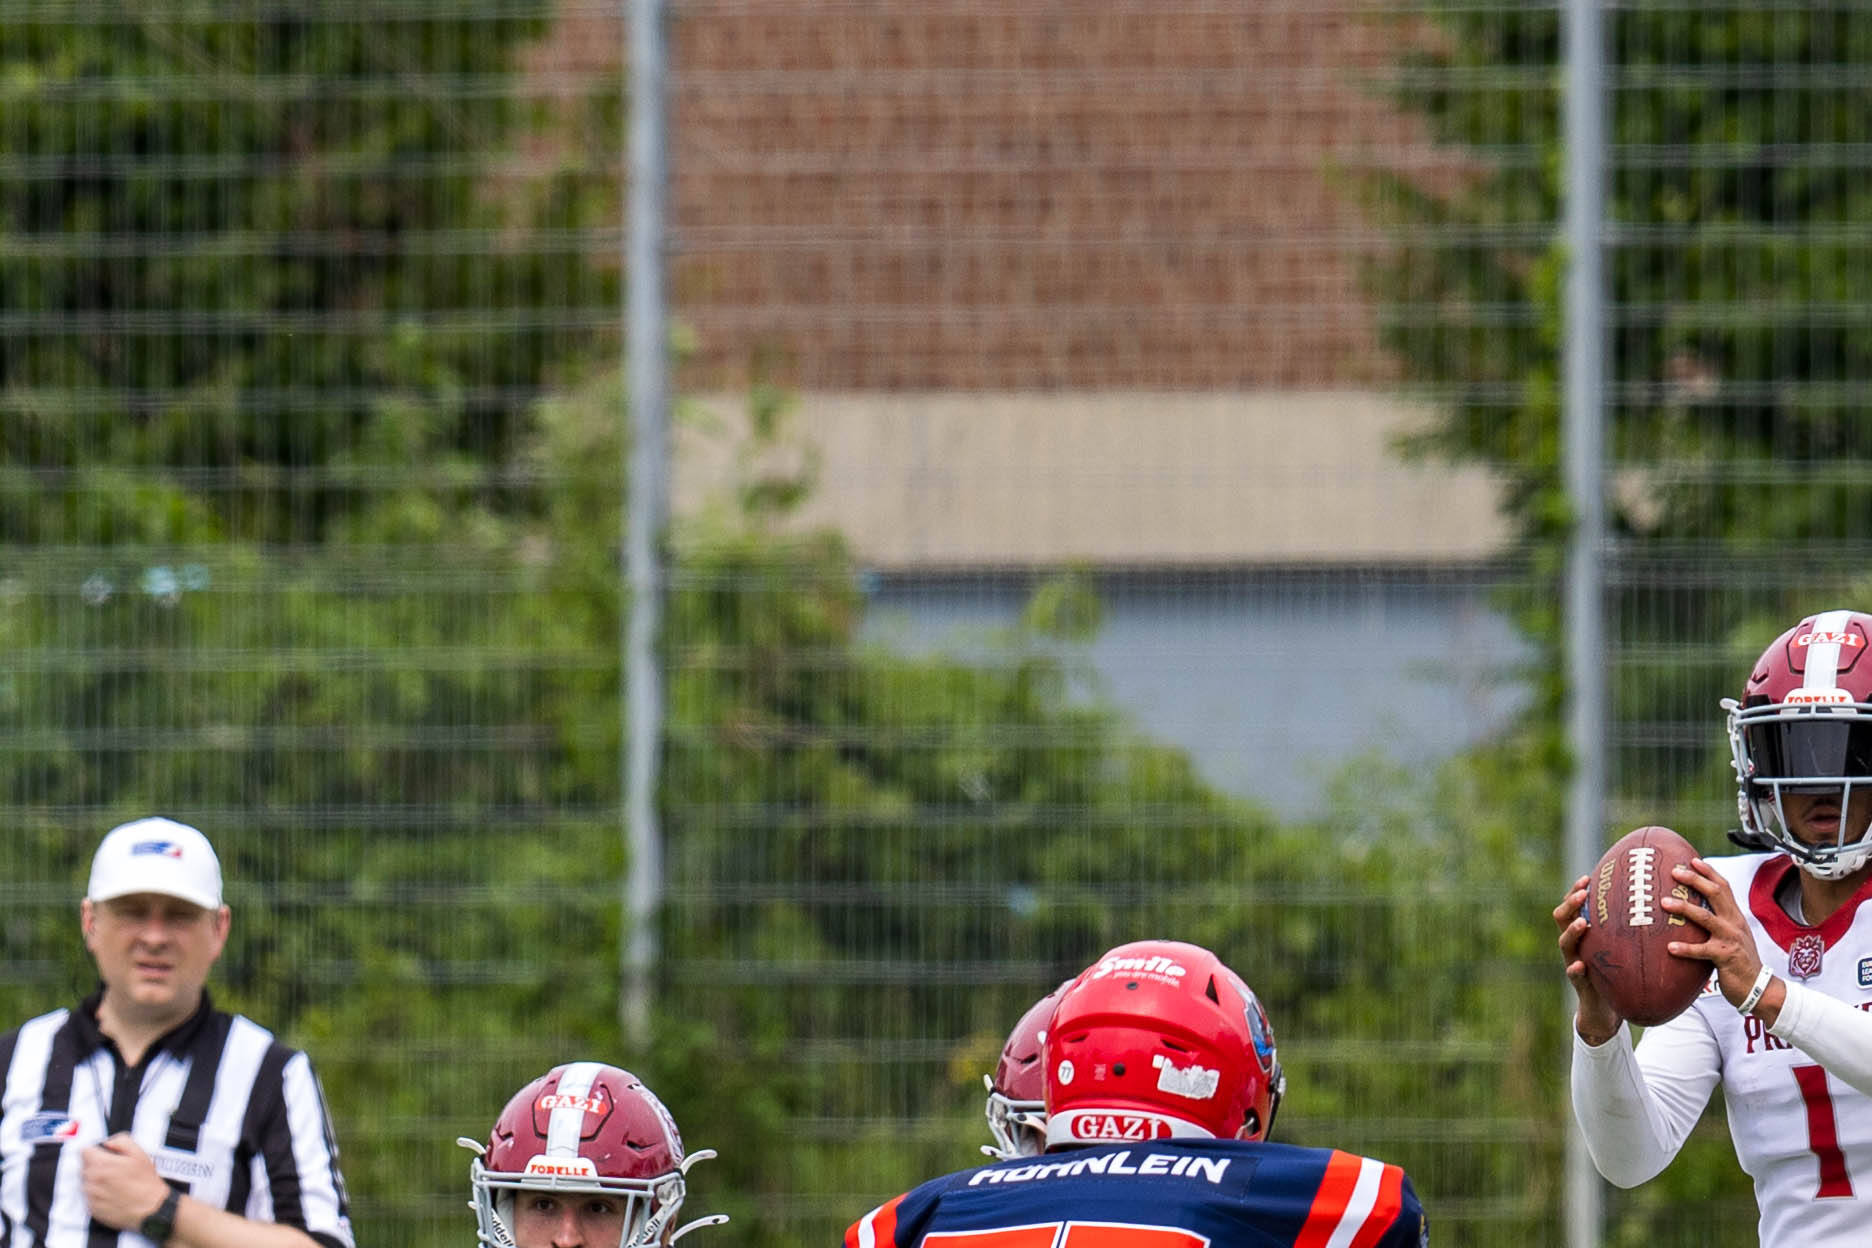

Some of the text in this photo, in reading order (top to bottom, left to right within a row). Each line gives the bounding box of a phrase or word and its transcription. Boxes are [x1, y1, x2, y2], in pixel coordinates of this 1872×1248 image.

[1798, 632, 1857, 647] GAZI
[1597, 858, 1616, 924] Wilson
[1093, 956, 1187, 979] Smile
[540, 1094, 602, 1114] GAZI
[1078, 1115, 1161, 1139] GAZI
[1790, 1064, 1856, 1199] 1
[530, 1164, 589, 1176] FORELLE
